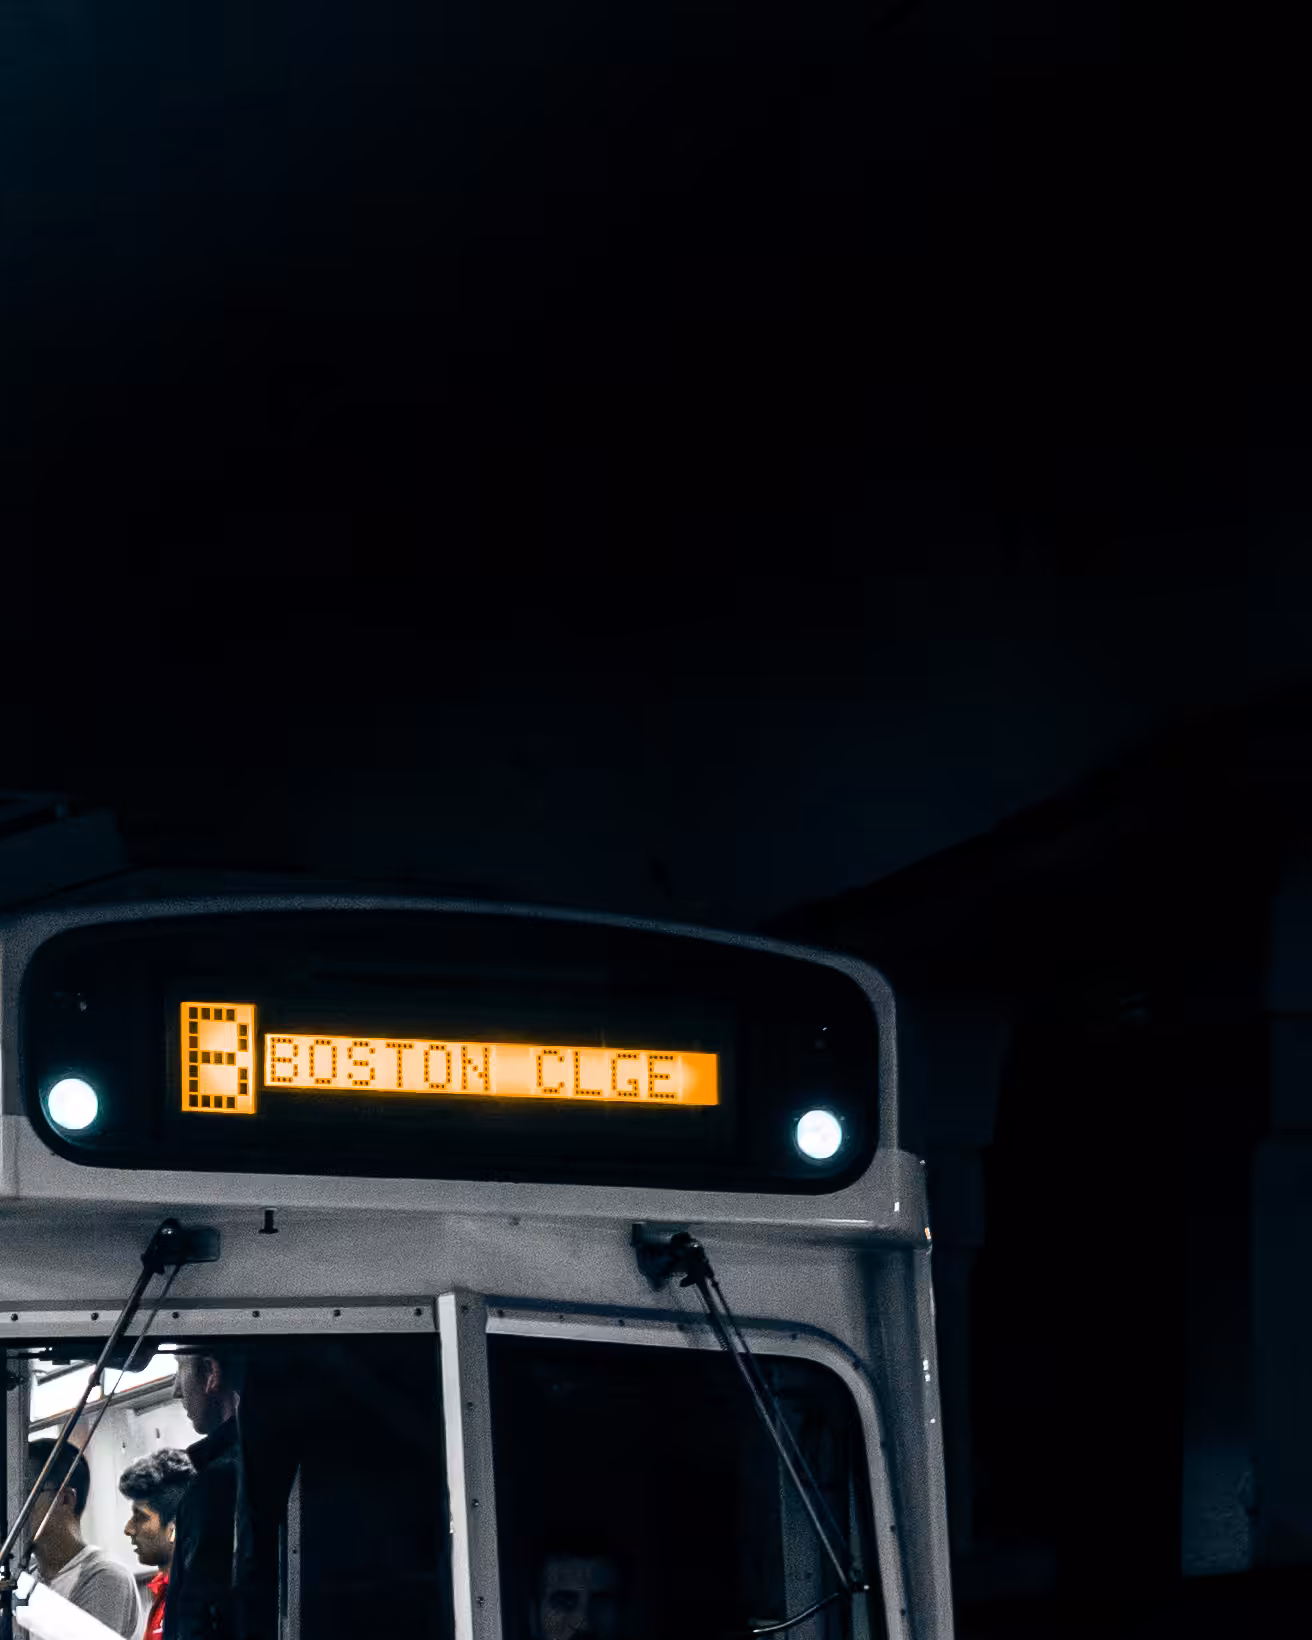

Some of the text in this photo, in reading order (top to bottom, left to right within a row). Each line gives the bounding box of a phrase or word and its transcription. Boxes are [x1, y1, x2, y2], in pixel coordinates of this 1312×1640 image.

[188, 1006, 677, 1110] B BOSTON CLGE
